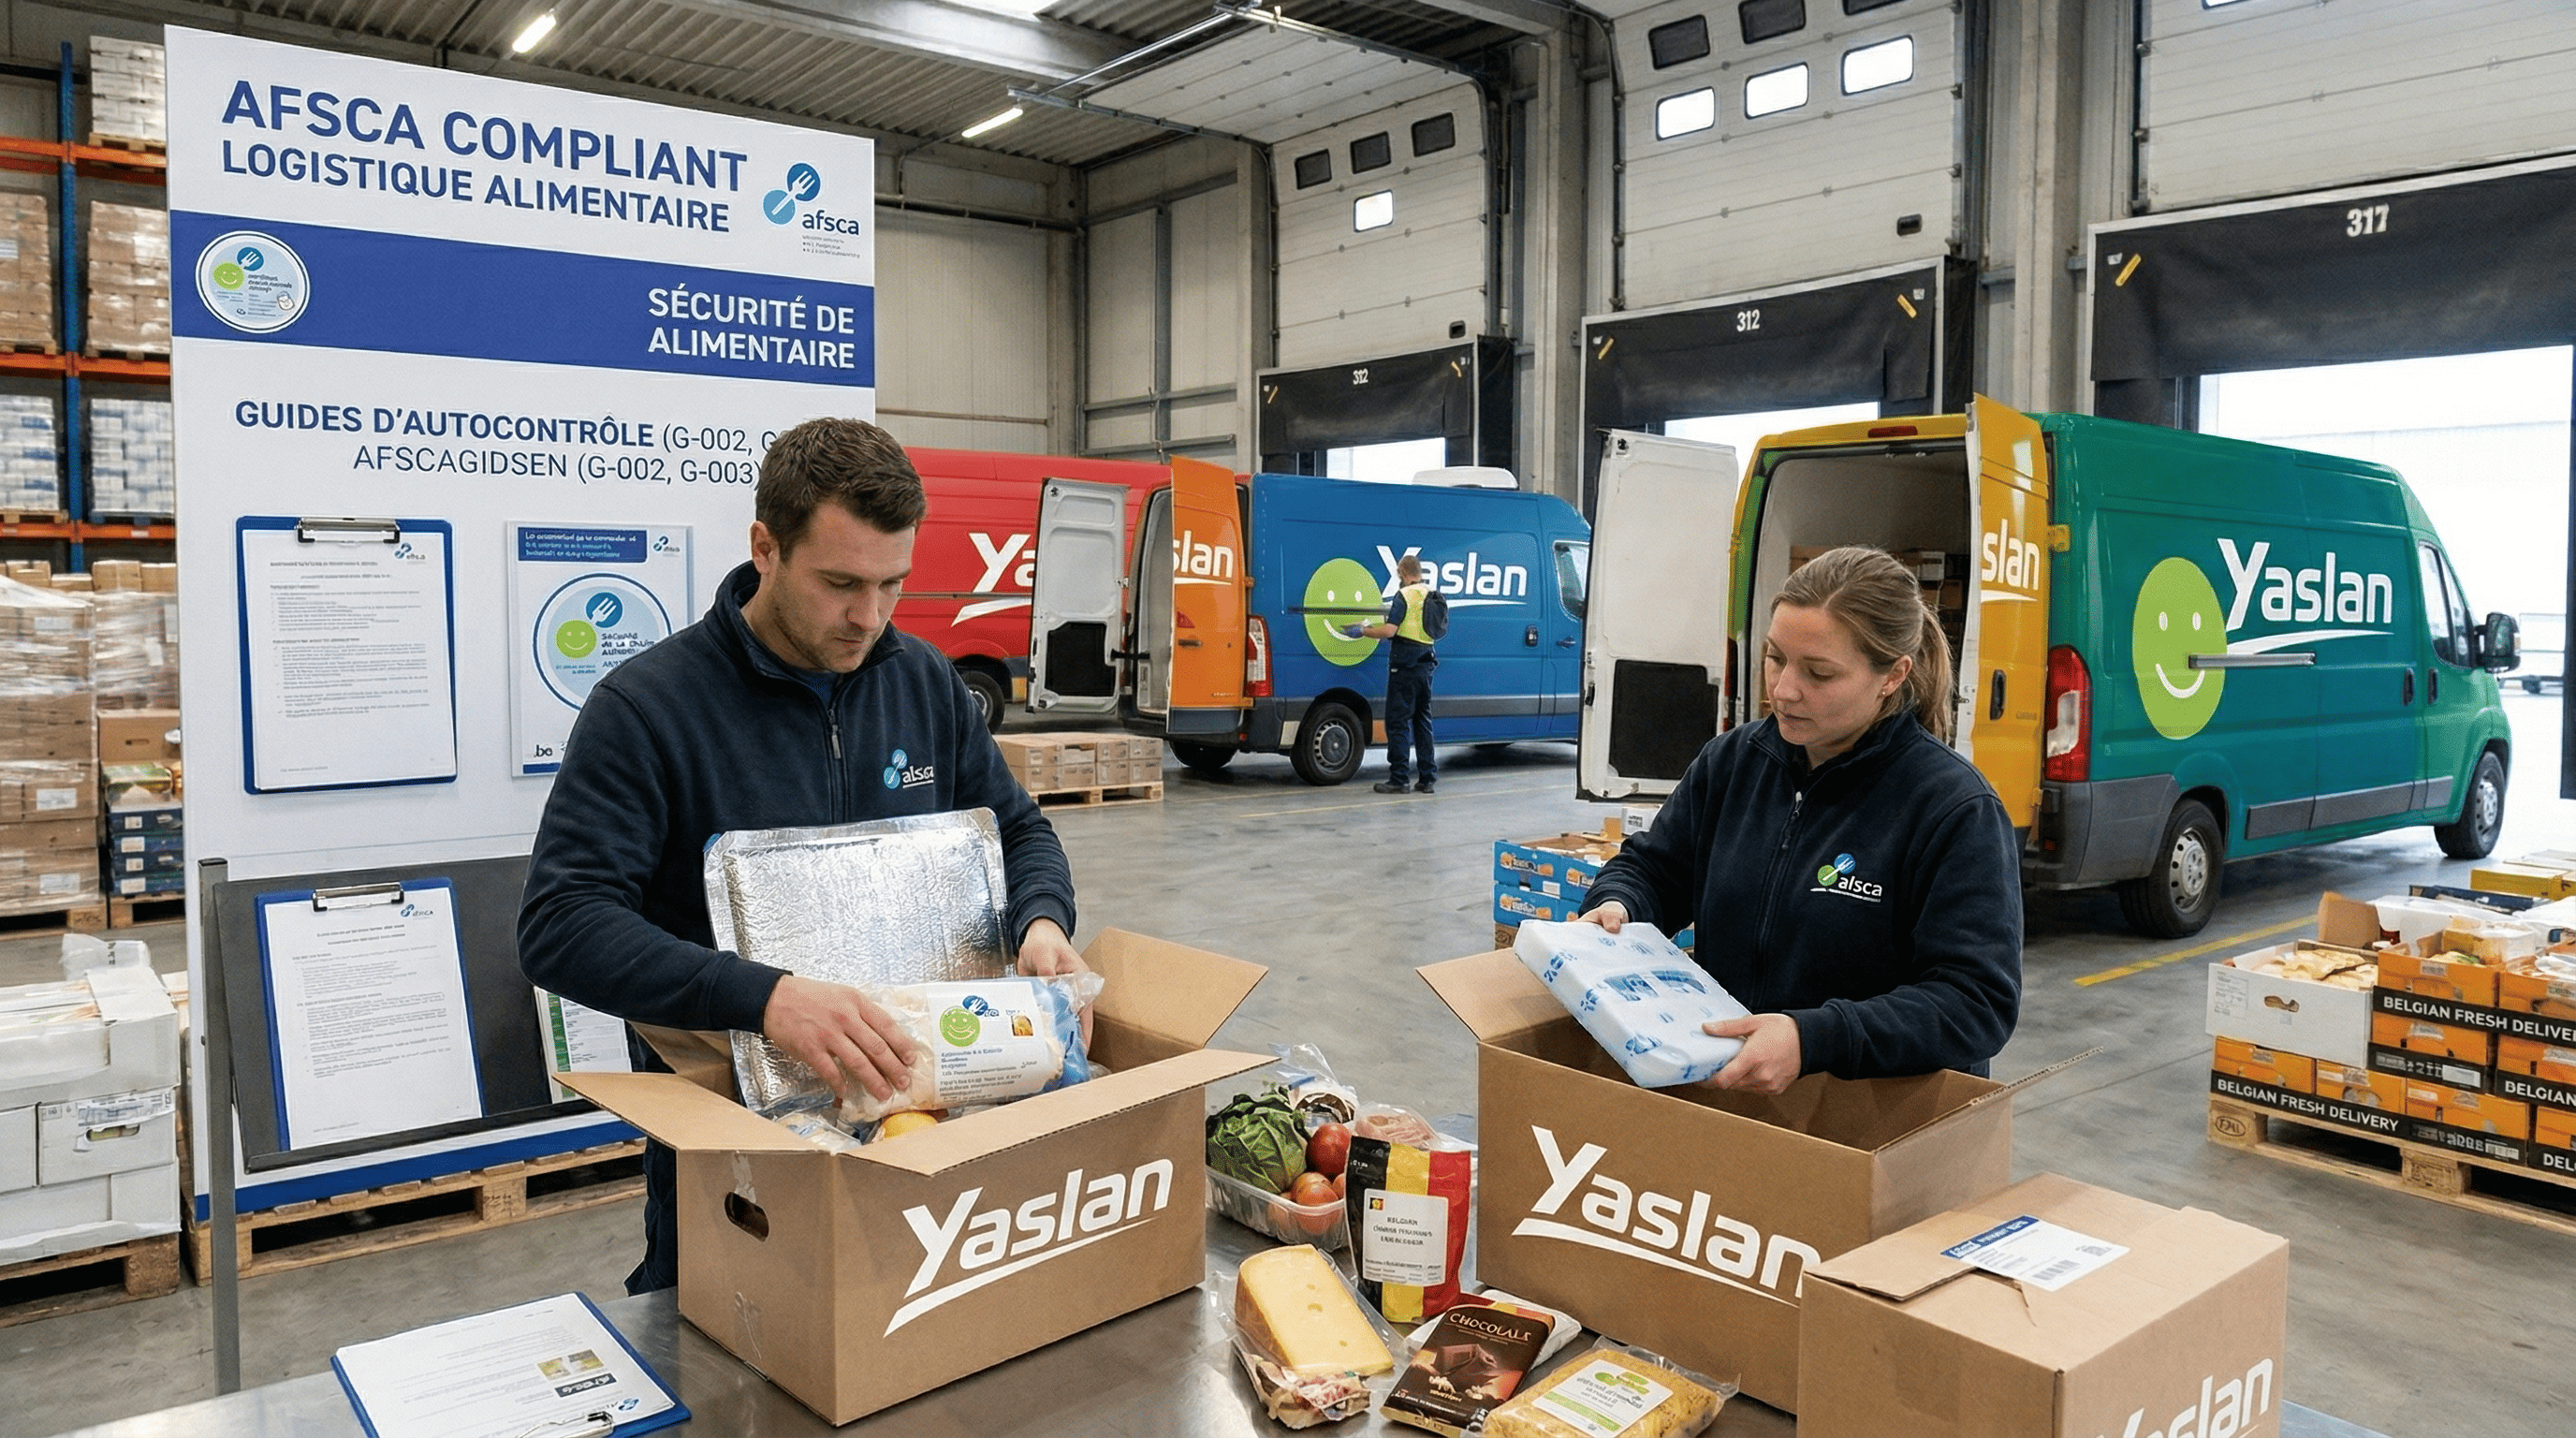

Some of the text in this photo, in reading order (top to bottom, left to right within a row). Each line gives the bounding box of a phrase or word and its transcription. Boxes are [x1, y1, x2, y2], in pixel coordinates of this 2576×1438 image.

[222, 80, 748, 192] AFSCA COMPLIANT
[223, 139, 729, 233] LOGISTIQUE ALIMENTAIRE
[802, 209, 859, 236] afsca
[2347, 202, 2389, 237] 317
[648, 282, 855, 334] SÉCURITÉ DE
[1736, 309, 1760, 332] 312
[648, 327, 855, 369] ALIMENTAIRE
[236, 400, 362, 433] GUIDES
[373, 407, 654, 448] D'AUTOCONTRÔLE
[663, 423, 753, 456] (G-002,
[353, 445, 762, 492] AFSCAGIDSEN (G-002, G-003)
[2217, 537, 2393, 632] Yaslan
[2383, 996, 2451, 1020] BELGIAN
[2454, 1008, 2508, 1030] FRESH
[2217, 1078, 2399, 1132] BELGIAN FRESH DELIVERY
[2505, 1080, 2576, 1107] BELGIAN
[2543, 1152, 2576, 1172] DEL
[901, 1158, 1174, 1299] Yaslan
[1530, 1124, 1821, 1299] Yaslan
